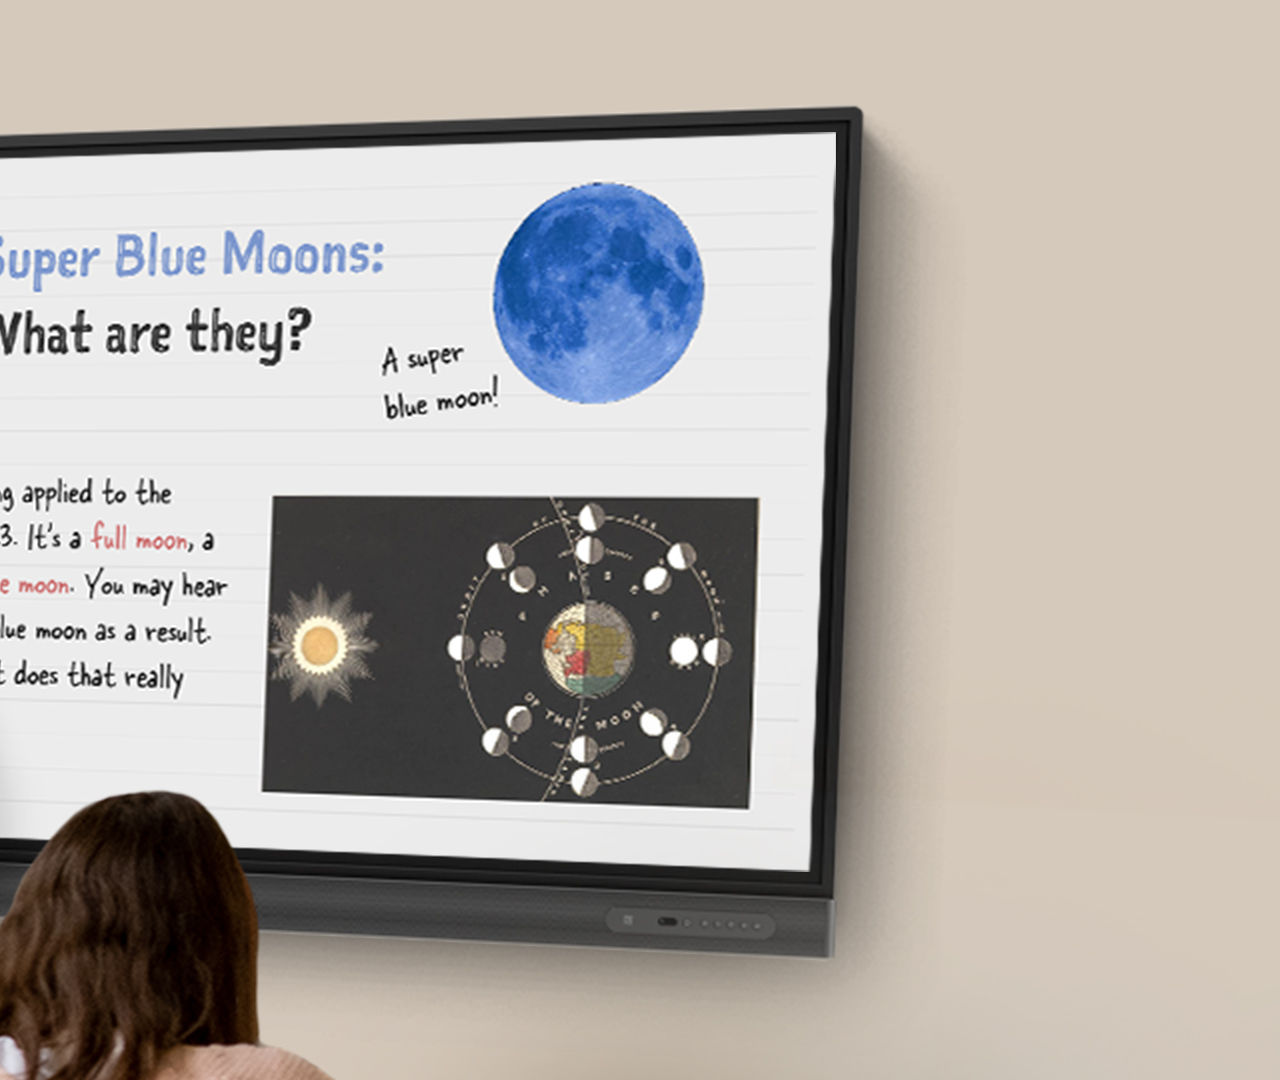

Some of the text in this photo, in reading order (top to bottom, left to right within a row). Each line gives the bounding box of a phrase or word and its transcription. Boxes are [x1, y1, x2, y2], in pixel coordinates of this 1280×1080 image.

[116, 232, 206, 277] Blue
[224, 230, 383, 274] Moons:
[106, 323, 171, 354] are
[186, 307, 312, 366] they?
[382, 347, 464, 376] A super
[384, 374, 498, 420] blue moon!
[22, 478, 92, 512] applied
[102, 478, 127, 505] to
[135, 478, 171, 505] the
[28, 522, 61, 550] It's
[69, 531, 81, 549] a
[91, 520, 126, 549] full
[136, 536, 194, 552] moon,
[202, 532, 214, 550] a
[19, 579, 74, 593] moon.
[85, 567, 124, 599] You
[133, 579, 173, 606] may
[182, 572, 228, 598] hear
[36, 626, 87, 640] moon
[95, 623, 116, 641] as
[124, 624, 136, 642] a
[145, 617, 211, 644] result.
[14, 659, 58, 685] does
[67, 661, 116, 688] that
[125, 663, 184, 699] really
